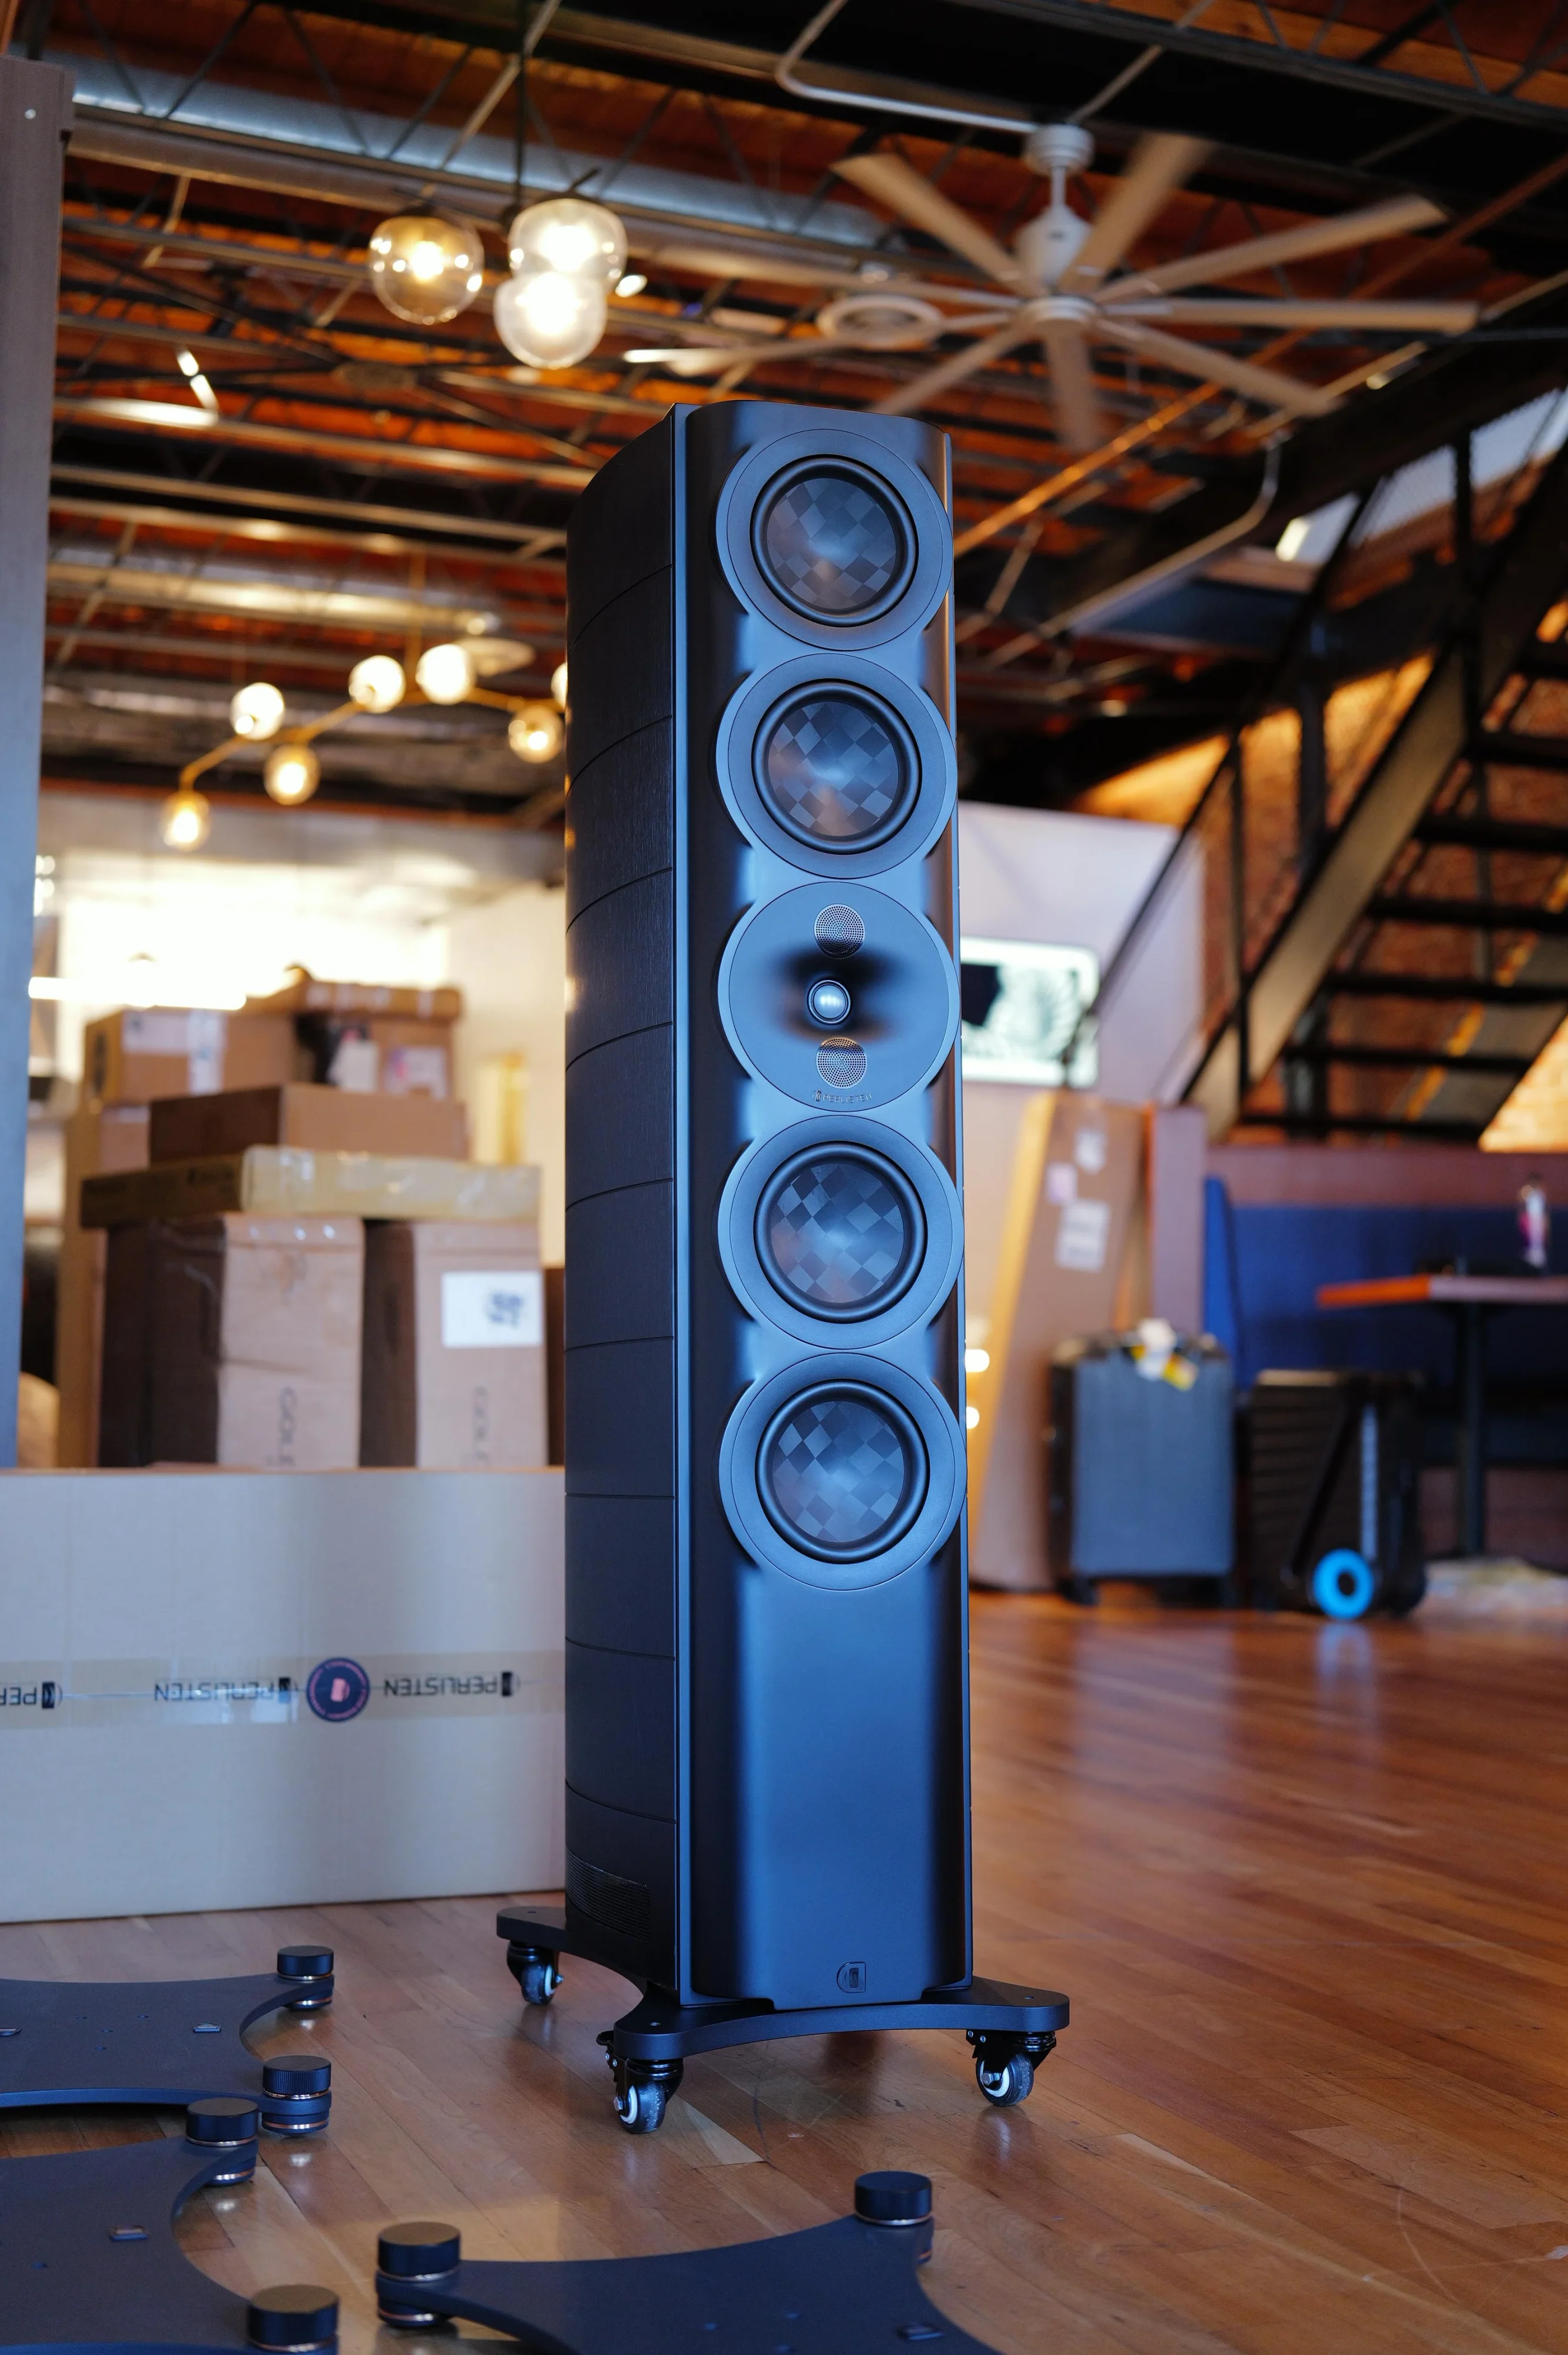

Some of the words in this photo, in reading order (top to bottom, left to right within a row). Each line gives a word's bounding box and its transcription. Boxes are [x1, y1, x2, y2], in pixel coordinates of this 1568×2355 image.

[823, 1092, 871, 1103] PERLISTEN
[154, 1681, 274, 1701] PERLISTEN
[384, 1675, 498, 1697] PERLISTEN
